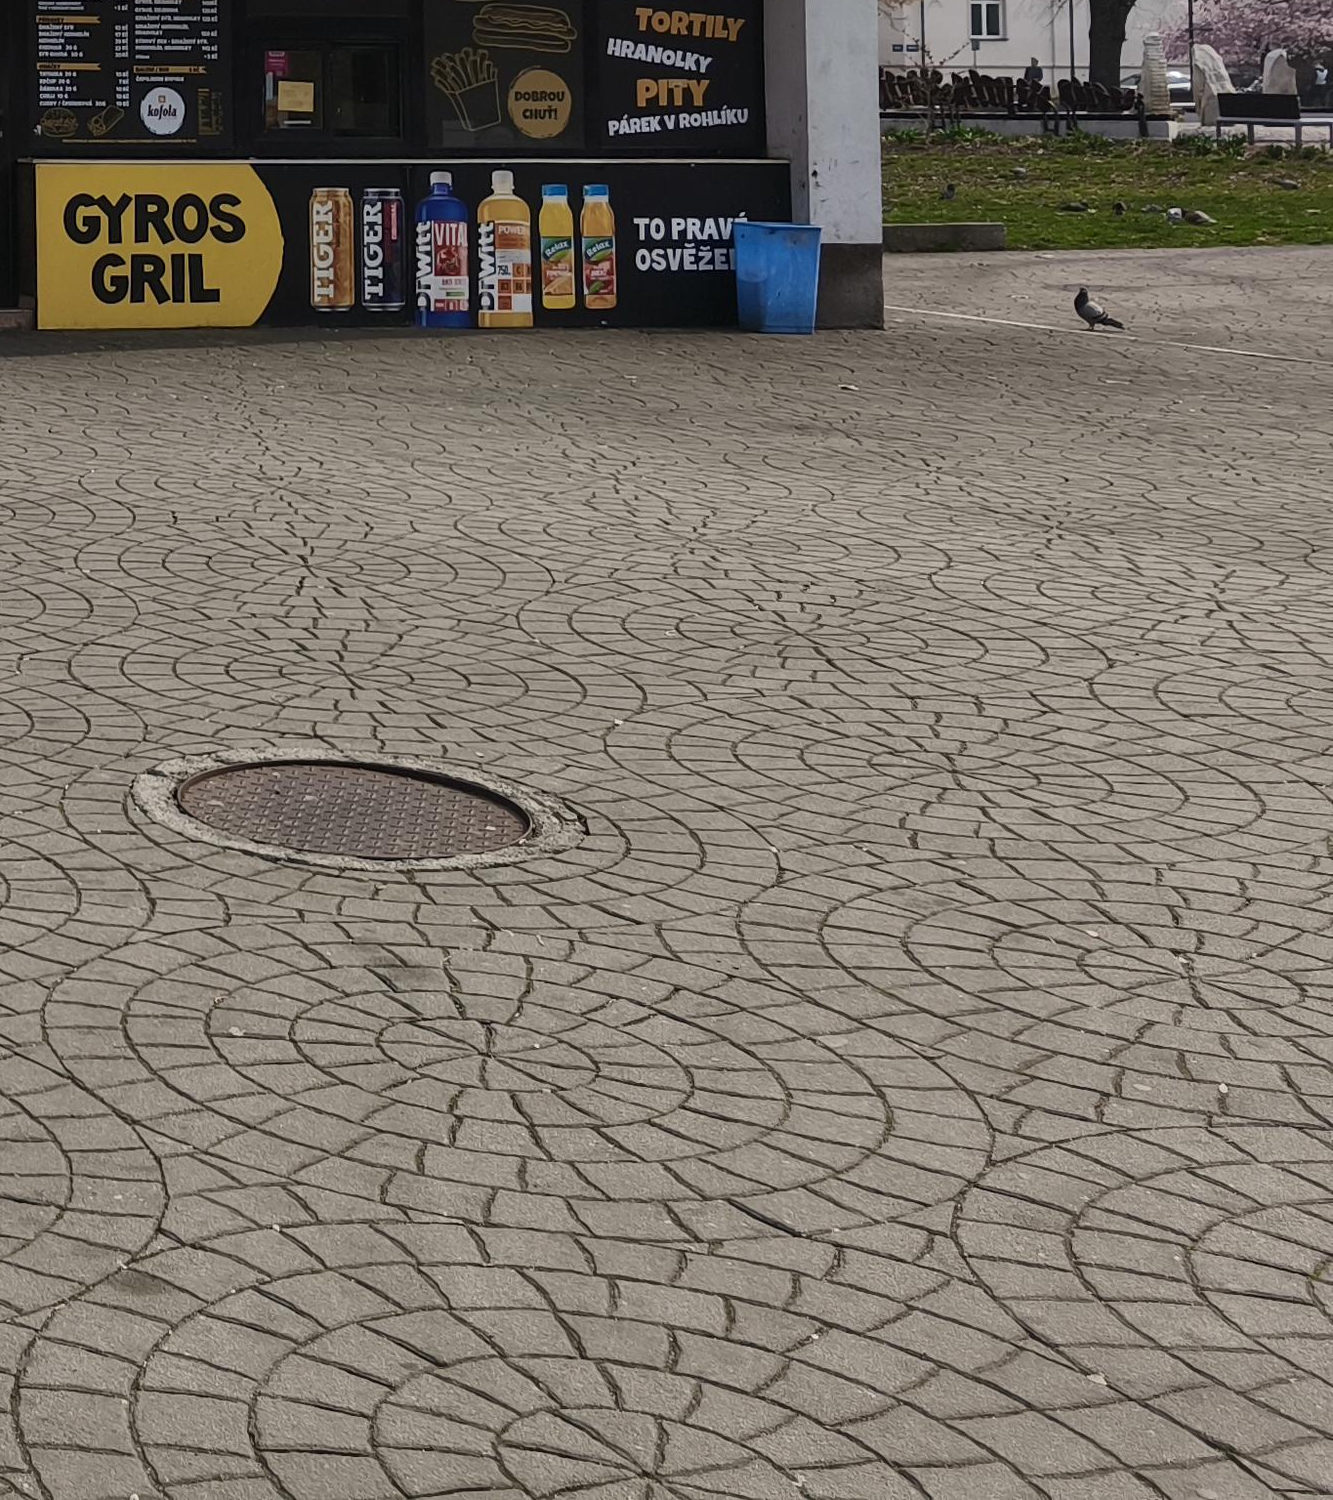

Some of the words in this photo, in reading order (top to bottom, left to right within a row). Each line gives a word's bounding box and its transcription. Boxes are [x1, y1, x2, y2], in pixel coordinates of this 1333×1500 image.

[635, 7, 746, 42] TORTILY
[606, 37, 713, 74] HRANOLKY
[514, 90, 566, 103] DOBROU
[636, 78, 710, 108] PITY
[147, 103, 177, 120] kofola
[522, 104, 558, 121] CHUŤ!
[607, 113, 662, 137] PÁREK
[663, 114, 677, 130] V
[679, 104, 749, 129] ROHLÍKU
[62, 192, 246, 245] GYROS
[633, 217, 665, 241] TO
[313, 200, 334, 302] TIGER
[363, 201, 384, 301] TIGER
[544, 240, 569, 258] Relax
[585, 240, 611, 257] Relax
[635, 242, 737, 272] OSVĚŽE
[91, 253, 221, 305] GRIL
